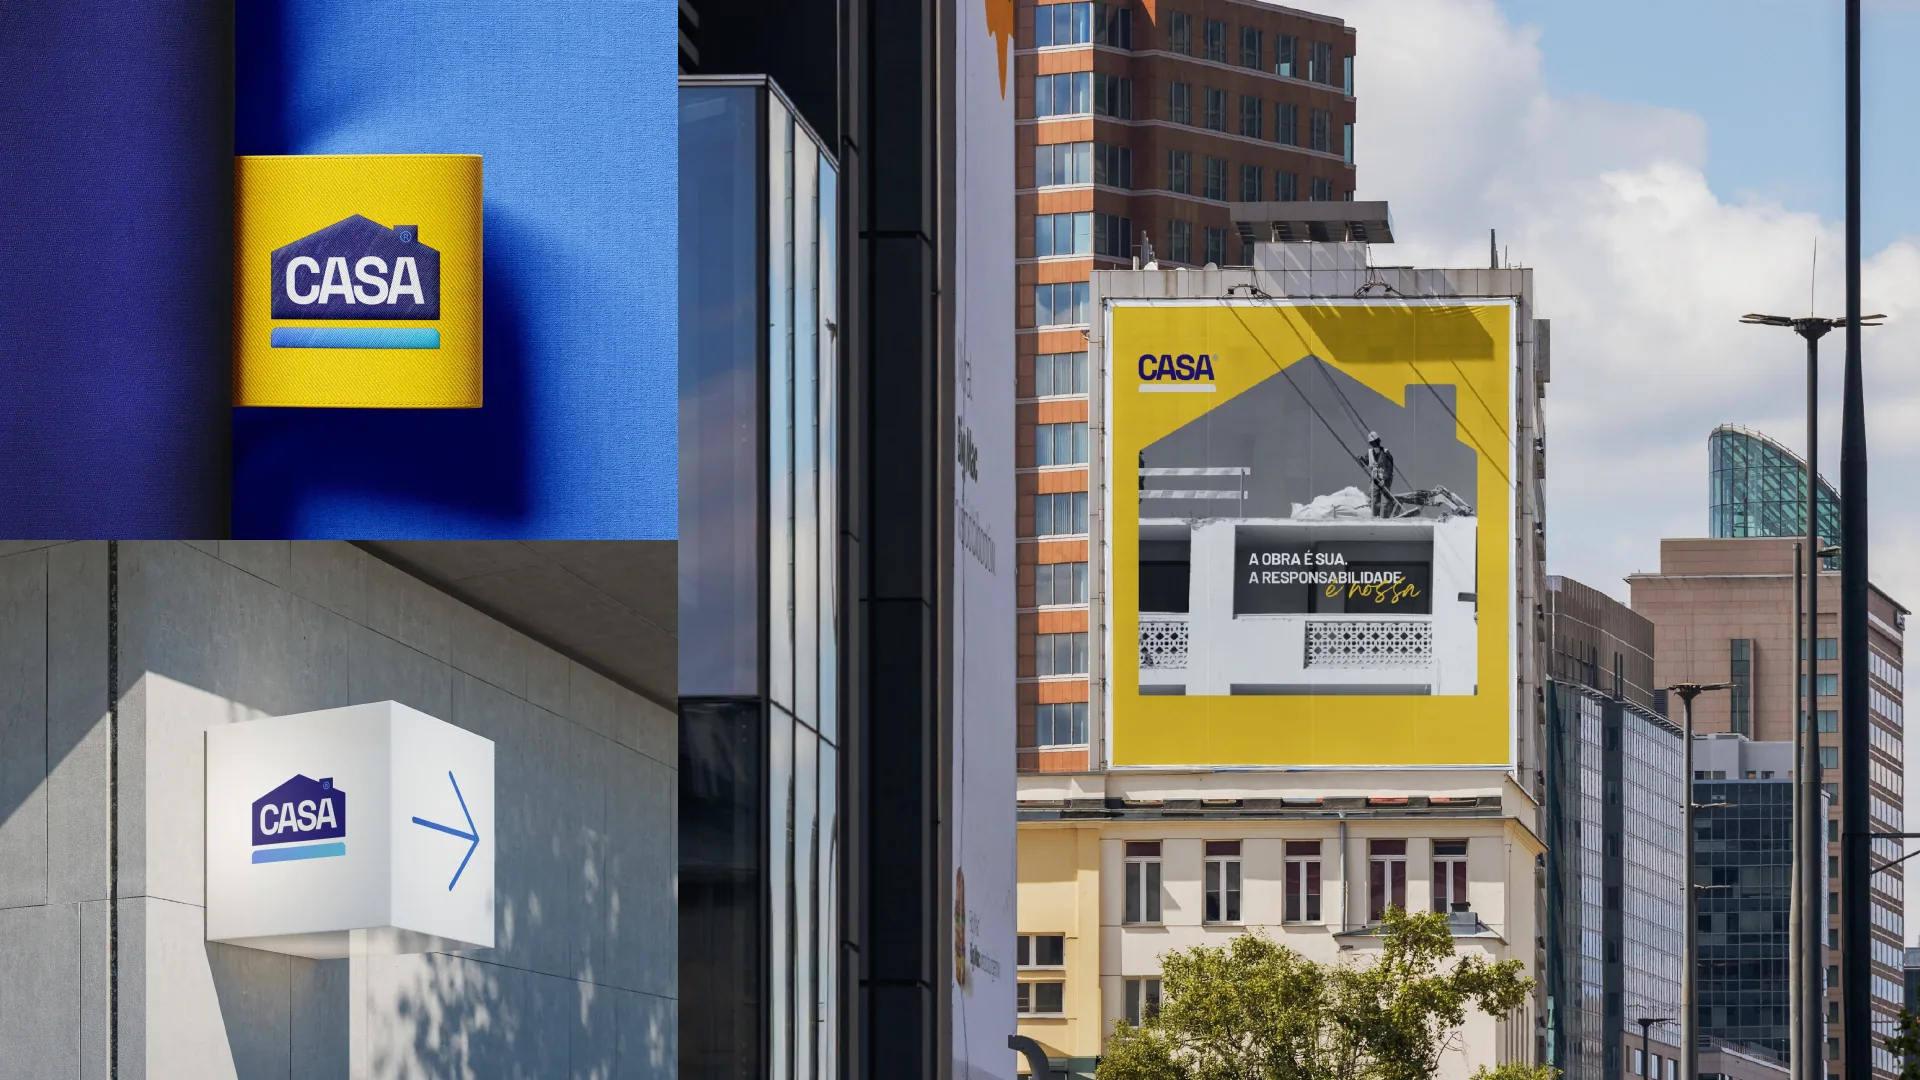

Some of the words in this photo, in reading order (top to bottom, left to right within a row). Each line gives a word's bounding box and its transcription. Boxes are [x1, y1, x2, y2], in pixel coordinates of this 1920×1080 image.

[286, 256, 425, 305] CASA
[1138, 354, 1214, 380] CASA
[1249, 553, 1259, 566] A
[1262, 553, 1301, 566] OBRA
[1304, 550, 1313, 566] É
[1315, 553, 1348, 566] SUA.
[1249, 571, 1259, 584] A
[1262, 571, 1402, 584] RESPONSABILIDADE
[1348, 576, 1421, 604] nossa
[260, 798, 337, 836] CASA
